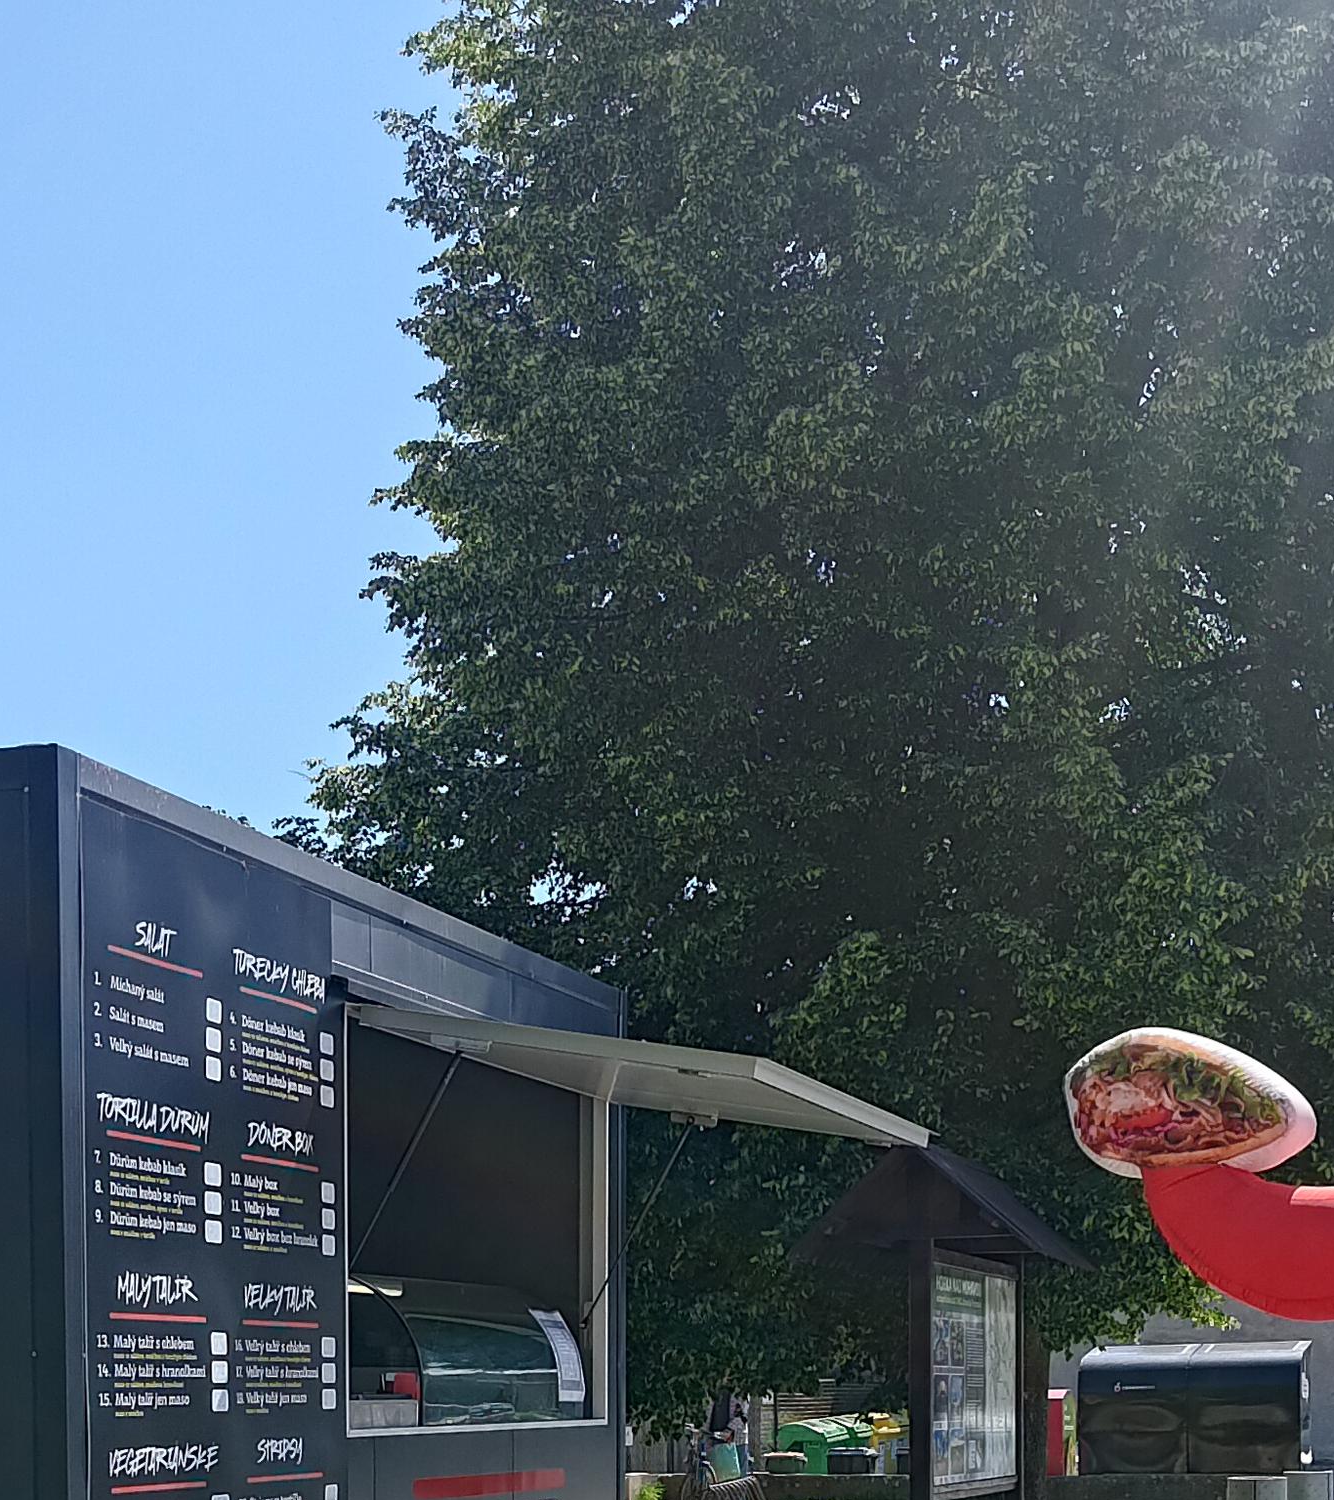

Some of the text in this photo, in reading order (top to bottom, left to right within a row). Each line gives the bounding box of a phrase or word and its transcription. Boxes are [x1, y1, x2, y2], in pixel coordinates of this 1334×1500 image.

[94, 971, 102, 986] 1.
[232, 948, 326, 1005] TURECKÝ CHLEBA
[109, 1006, 130, 1024] Salát
[131, 1015, 137, 1026] s
[137, 1016, 164, 1033] masem
[229, 1011, 237, 1025] 4.
[265, 1019, 286, 1037] kebab
[94, 1033, 189, 1068] 3. Velký salát s masem
[229, 1038, 237, 1052] 5.
[265, 1046, 286, 1063] kebab
[229, 1065, 237, 1079] 6.
[266, 1072, 287, 1089] kebab
[96, 1092, 157, 1134] TORTILLA
[294, 1130, 315, 1157] BOX
[138, 1157, 162, 1175] kebab
[230, 1172, 278, 1192] 10. Malý box
[138, 1184, 162, 1201] kebab
[163, 1193, 172, 1203] se
[173, 1191, 197, 1208] sýrem
[94, 1209, 104, 1224] 9.
[139, 1213, 163, 1231] kebab
[162, 1219, 176, 1234] jen
[176, 1221, 197, 1234] maso
[243, 1200, 265, 1219] Velký
[266, 1203, 280, 1217] box
[243, 1227, 265, 1245] Velký
[266, 1229, 280, 1243] box
[280, 1230, 293, 1245] bez
[117, 1270, 152, 1309] MALÝ
[244, 1283, 284, 1316] VELKÝ
[96, 1334, 195, 1354] 13. Malý talíř s chlebem
[245, 1339, 264, 1355] Velký
[97, 1363, 111, 1378] 14.
[114, 1365, 137, 1382] Malý
[138, 1363, 154, 1378] talíř
[155, 1368, 161, 1378] s
[98, 1391, 190, 1410] 15. Malý talíř jen maso
[257, 1437, 303, 1465] STRIPSY
